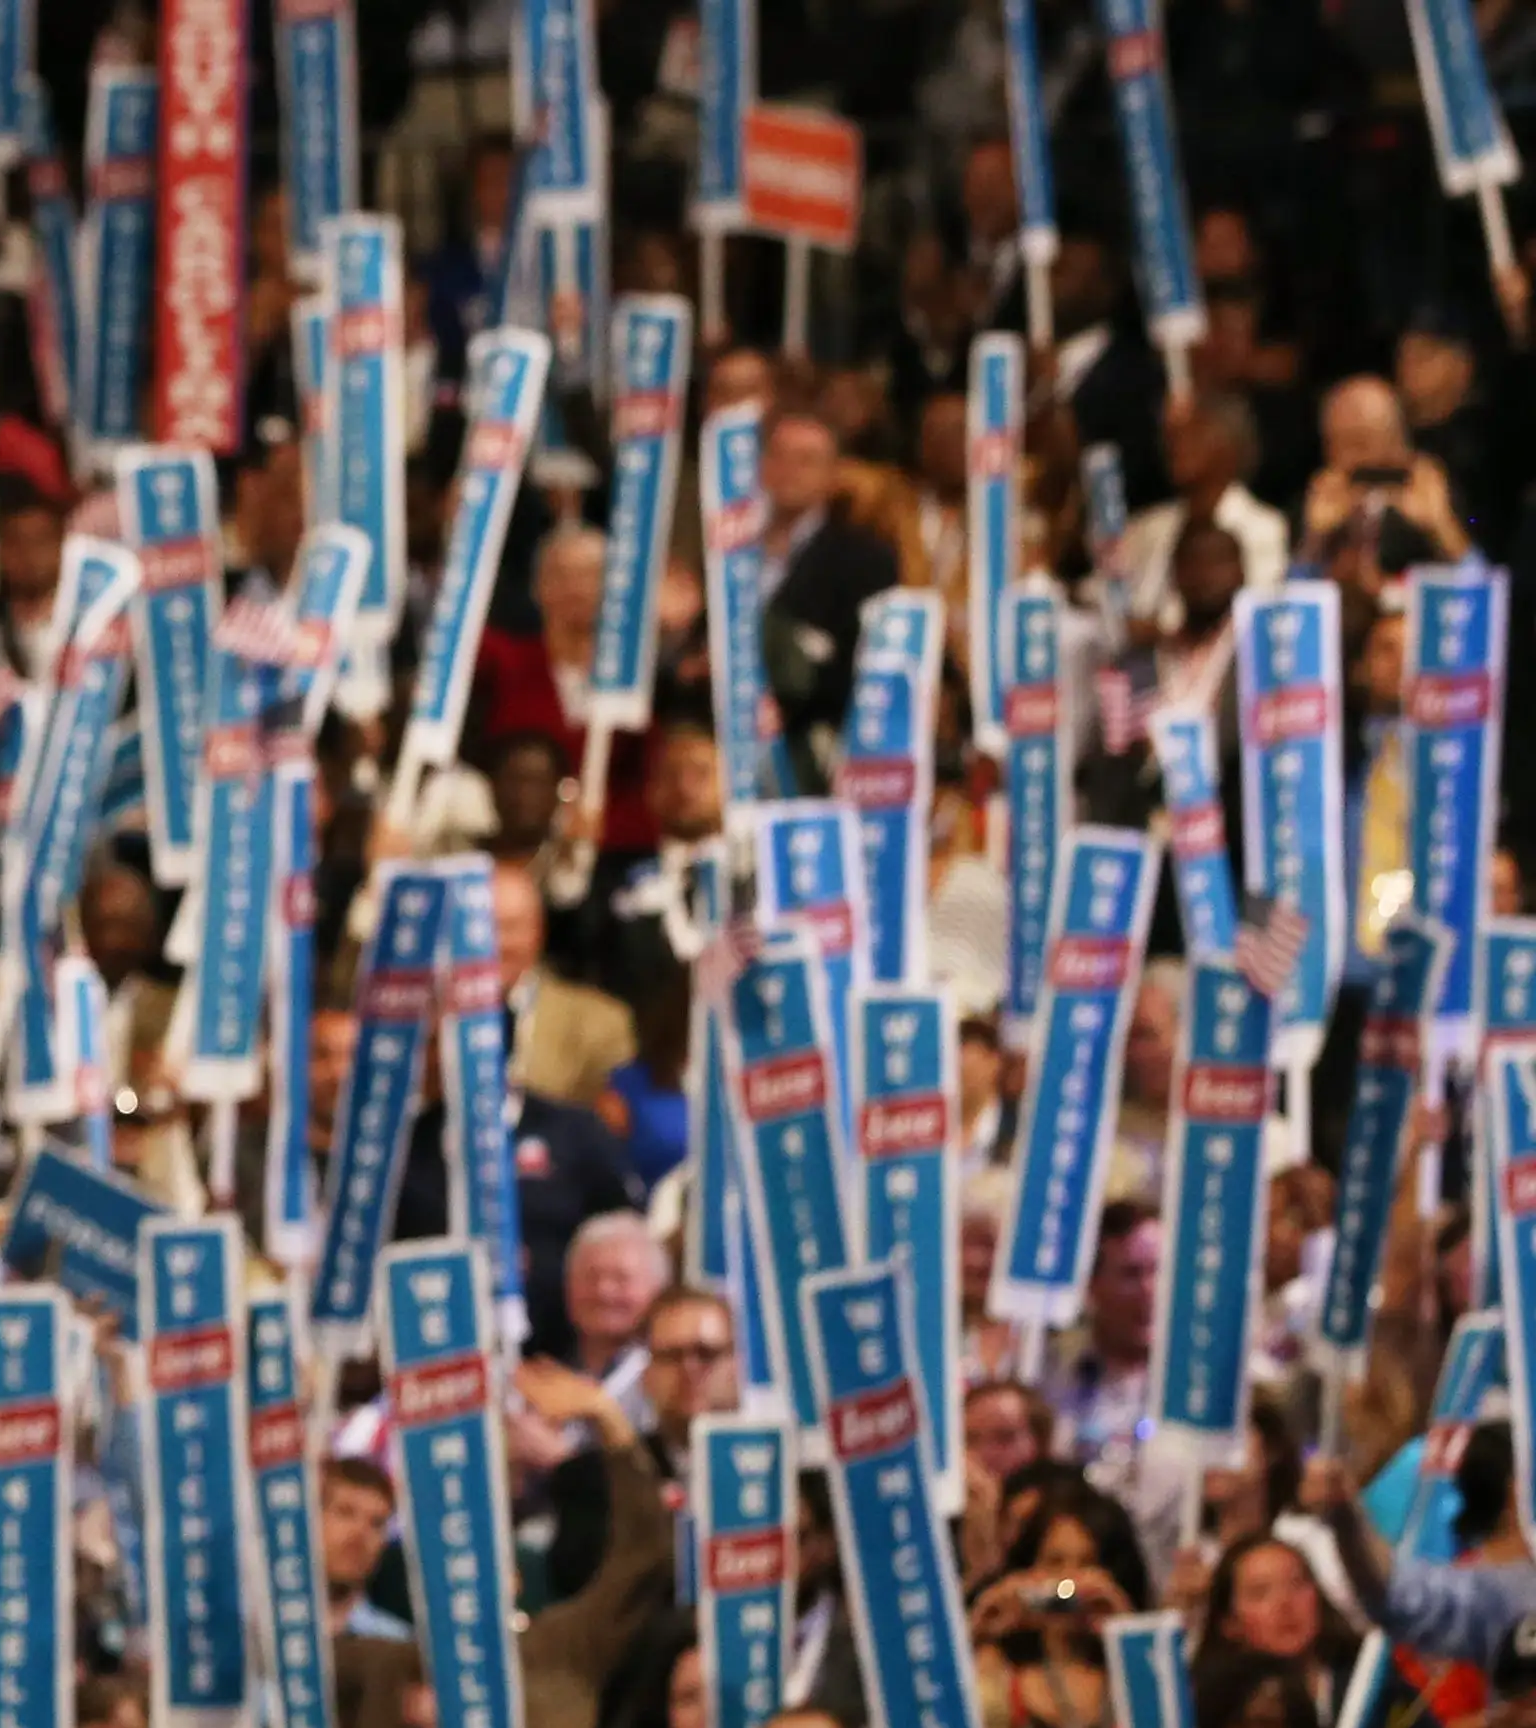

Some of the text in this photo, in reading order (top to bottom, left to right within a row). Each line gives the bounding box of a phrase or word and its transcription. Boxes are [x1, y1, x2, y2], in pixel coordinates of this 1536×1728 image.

[408, 1268, 453, 1347] WE
[842, 1296, 887, 1377] WE
[730, 1443, 777, 1520] WE
